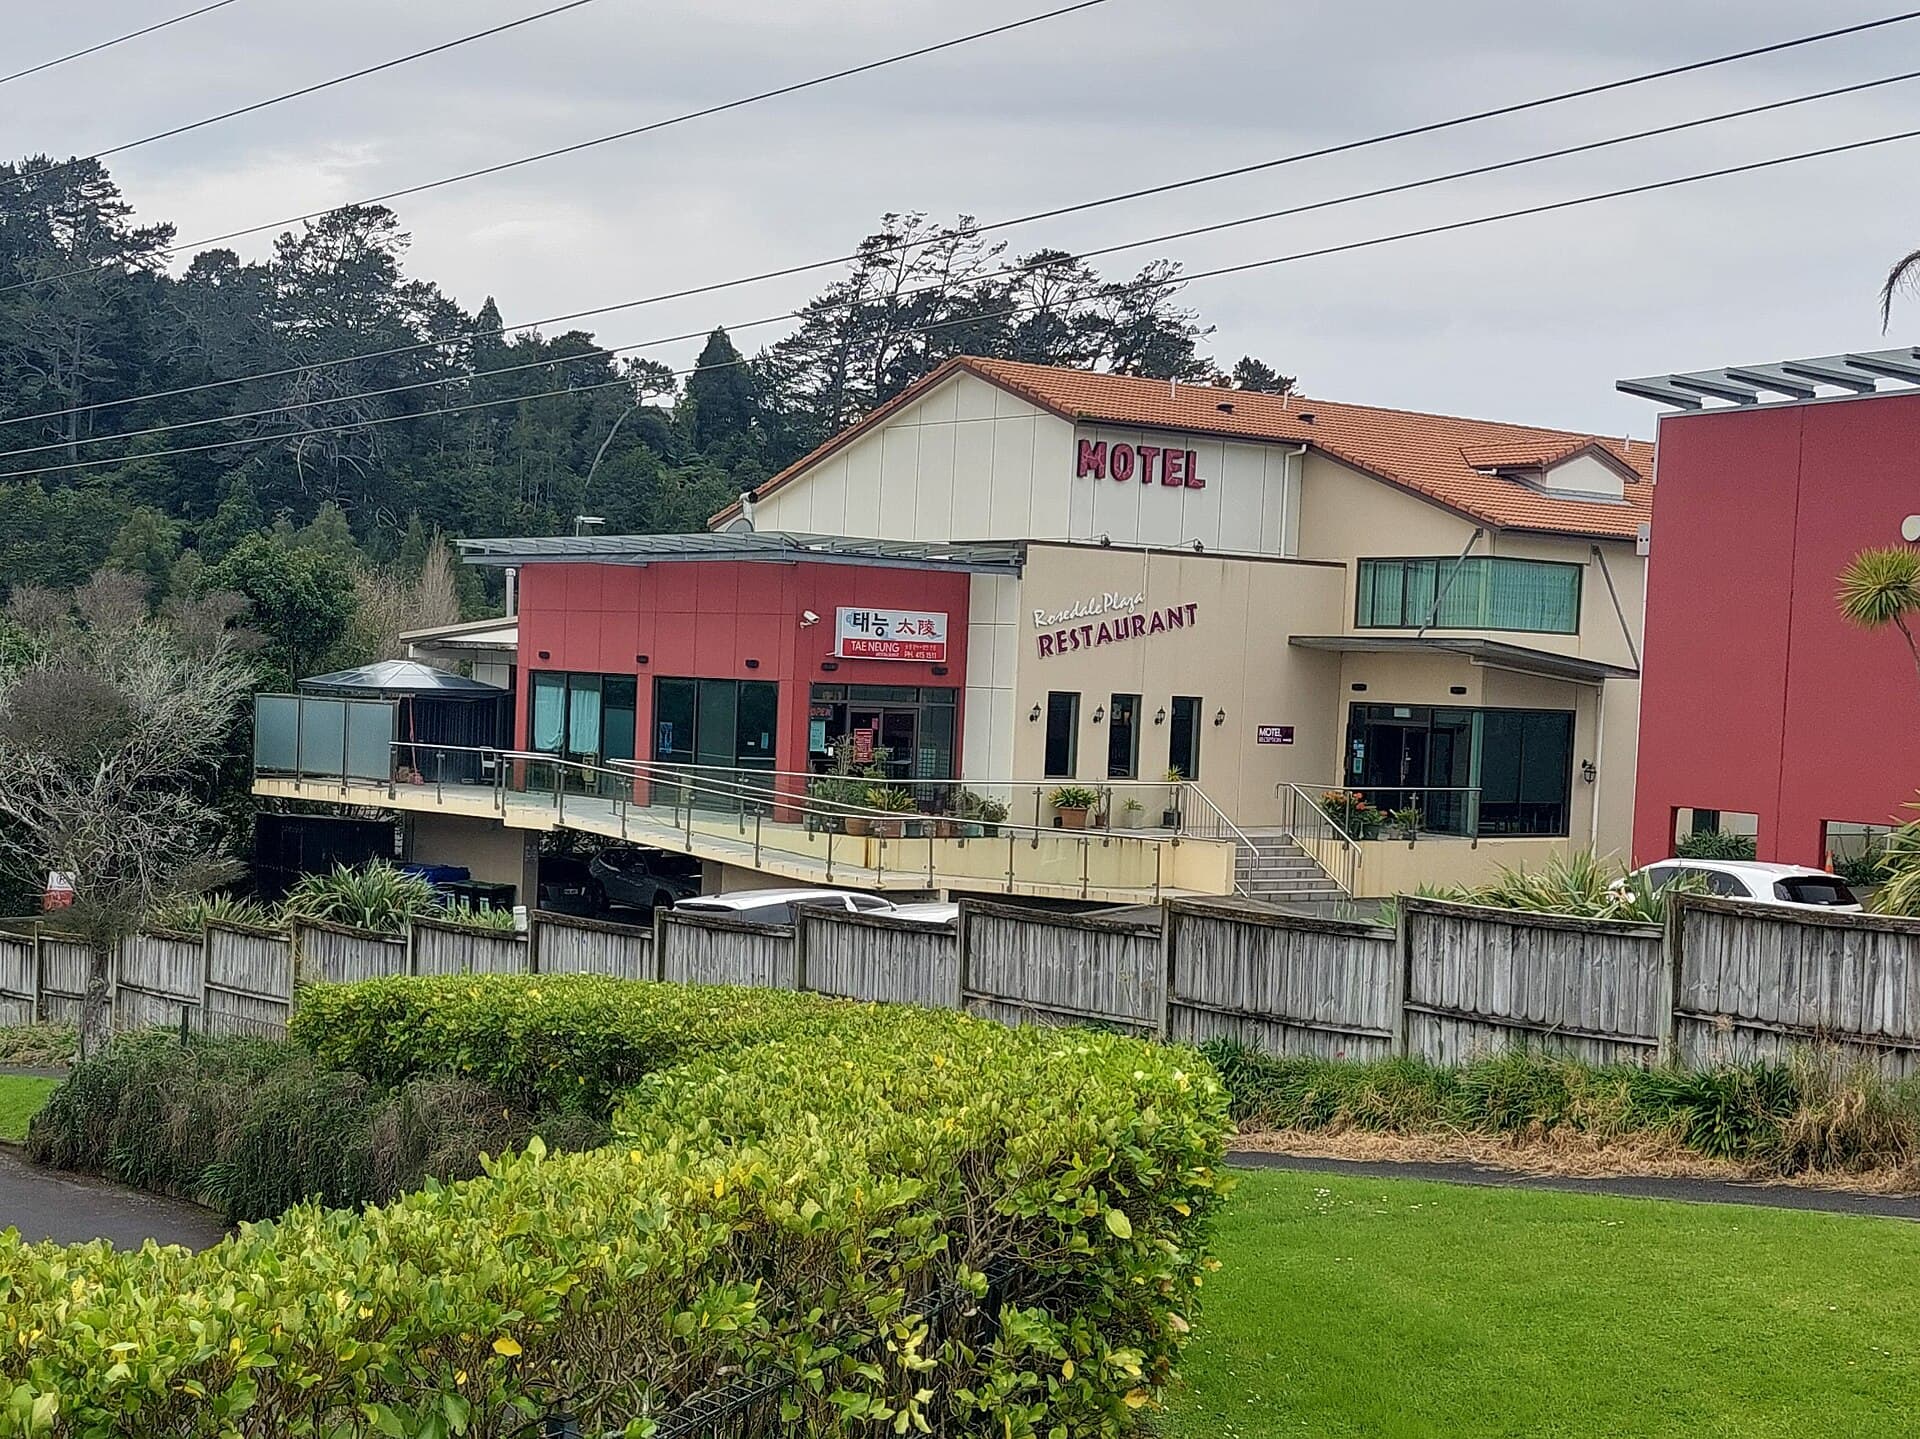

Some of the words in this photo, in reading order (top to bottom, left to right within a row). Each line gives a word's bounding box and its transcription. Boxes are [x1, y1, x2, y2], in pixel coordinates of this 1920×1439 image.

[1077, 439, 1205, 489] MOTEL
[1033, 598, 1102, 628] Rosedale
[1103, 592, 1145, 613] Plaza
[853, 612, 889, 637] 태능
[895, 618, 937, 636] 太陵
[1037, 603, 1198, 658] RESTAURANT
[851, 640, 866, 652] TAE
[867, 642, 900, 653] NEUNG
[1259, 727, 1282, 737] MOTEL
